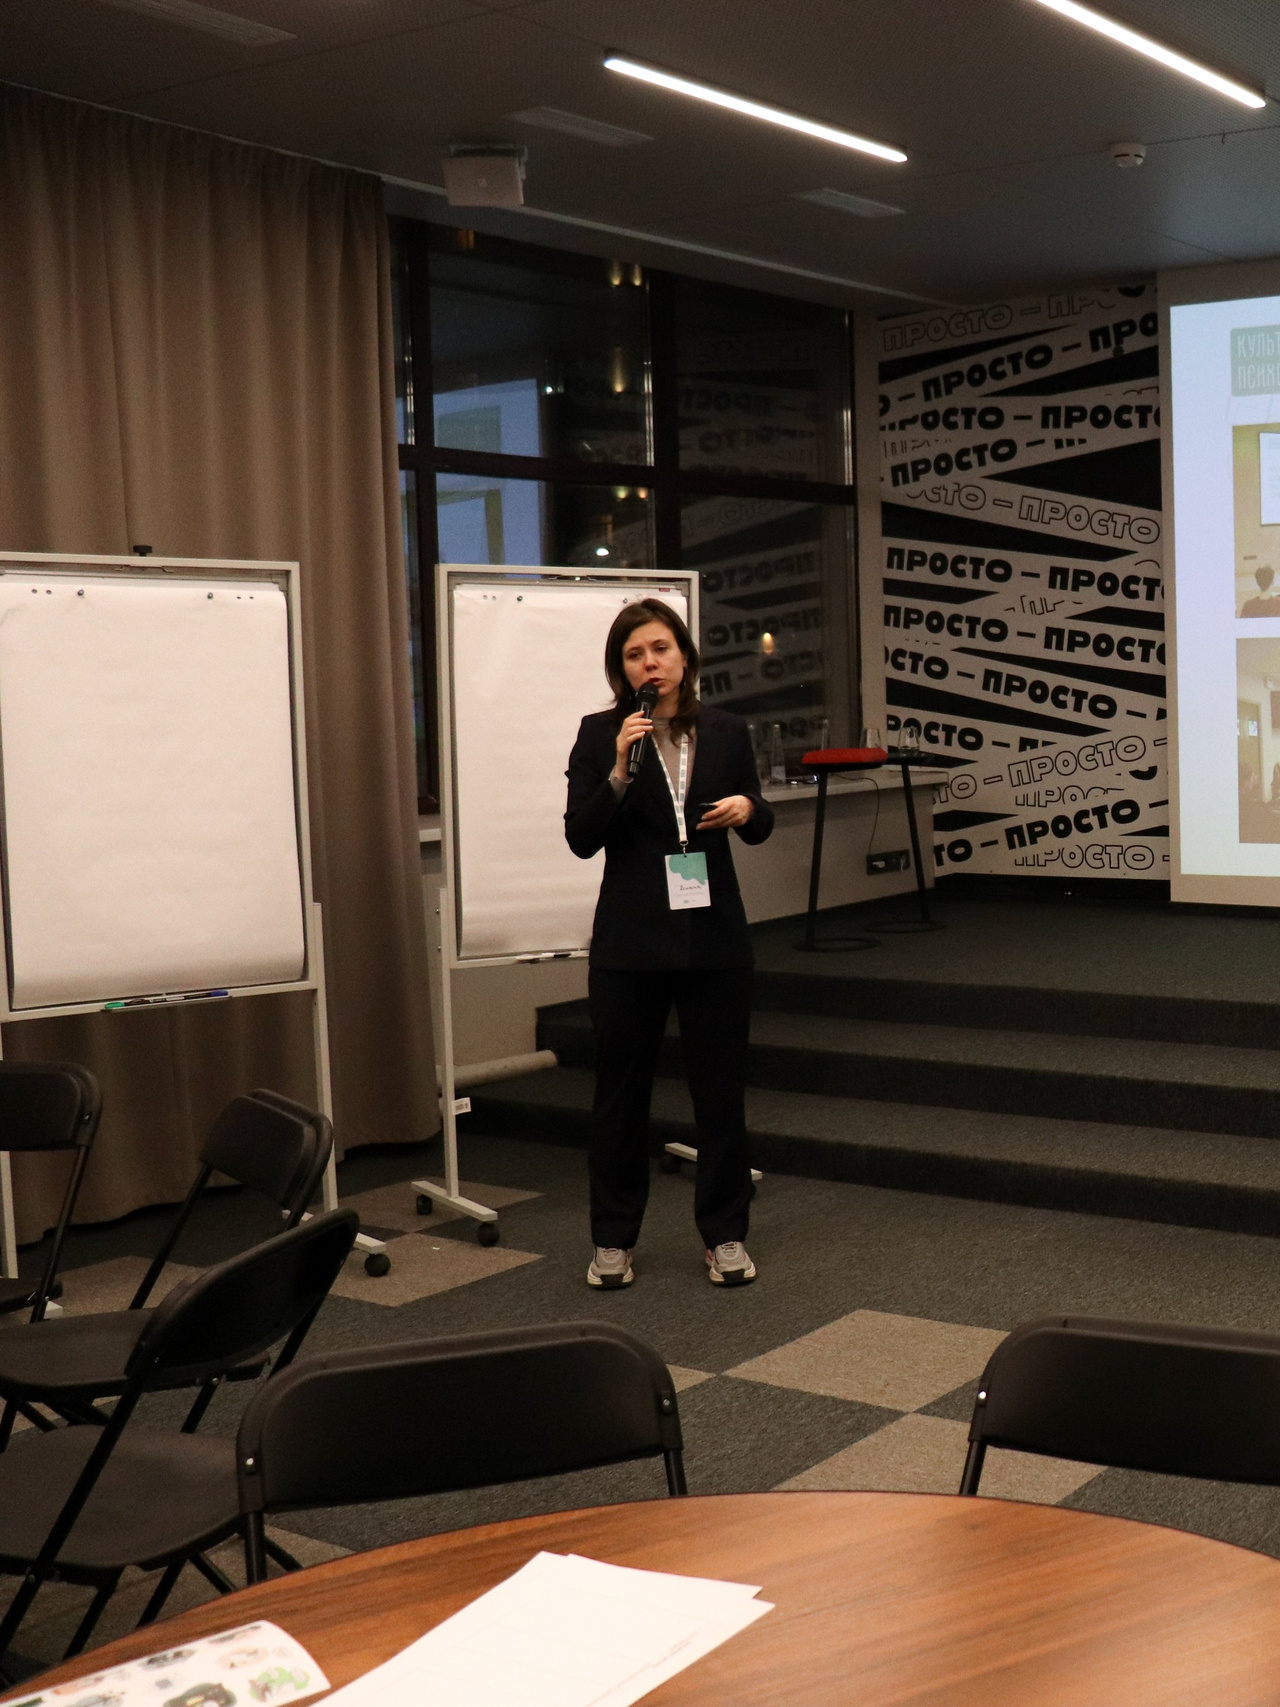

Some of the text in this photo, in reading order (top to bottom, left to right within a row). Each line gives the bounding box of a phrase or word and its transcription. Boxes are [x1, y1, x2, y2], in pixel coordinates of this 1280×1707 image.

[883, 302, 1013, 352] ПРОСТО
[921, 343, 1054, 403] ПРОСТО
[890, 438, 1018, 488] ПРОСТО
[906, 482, 1161, 545] СТО ПРОСТО
[886, 546, 1164, 603] ПРОСТО ПРОСТ
[884, 604, 1009, 643] ПРОСТО
[884, 645, 1117, 720] СТО ПРОСТО
[1007, 735, 1147, 788] ПРОСТО
[1004, 798, 1141, 852] ПРОСТО
